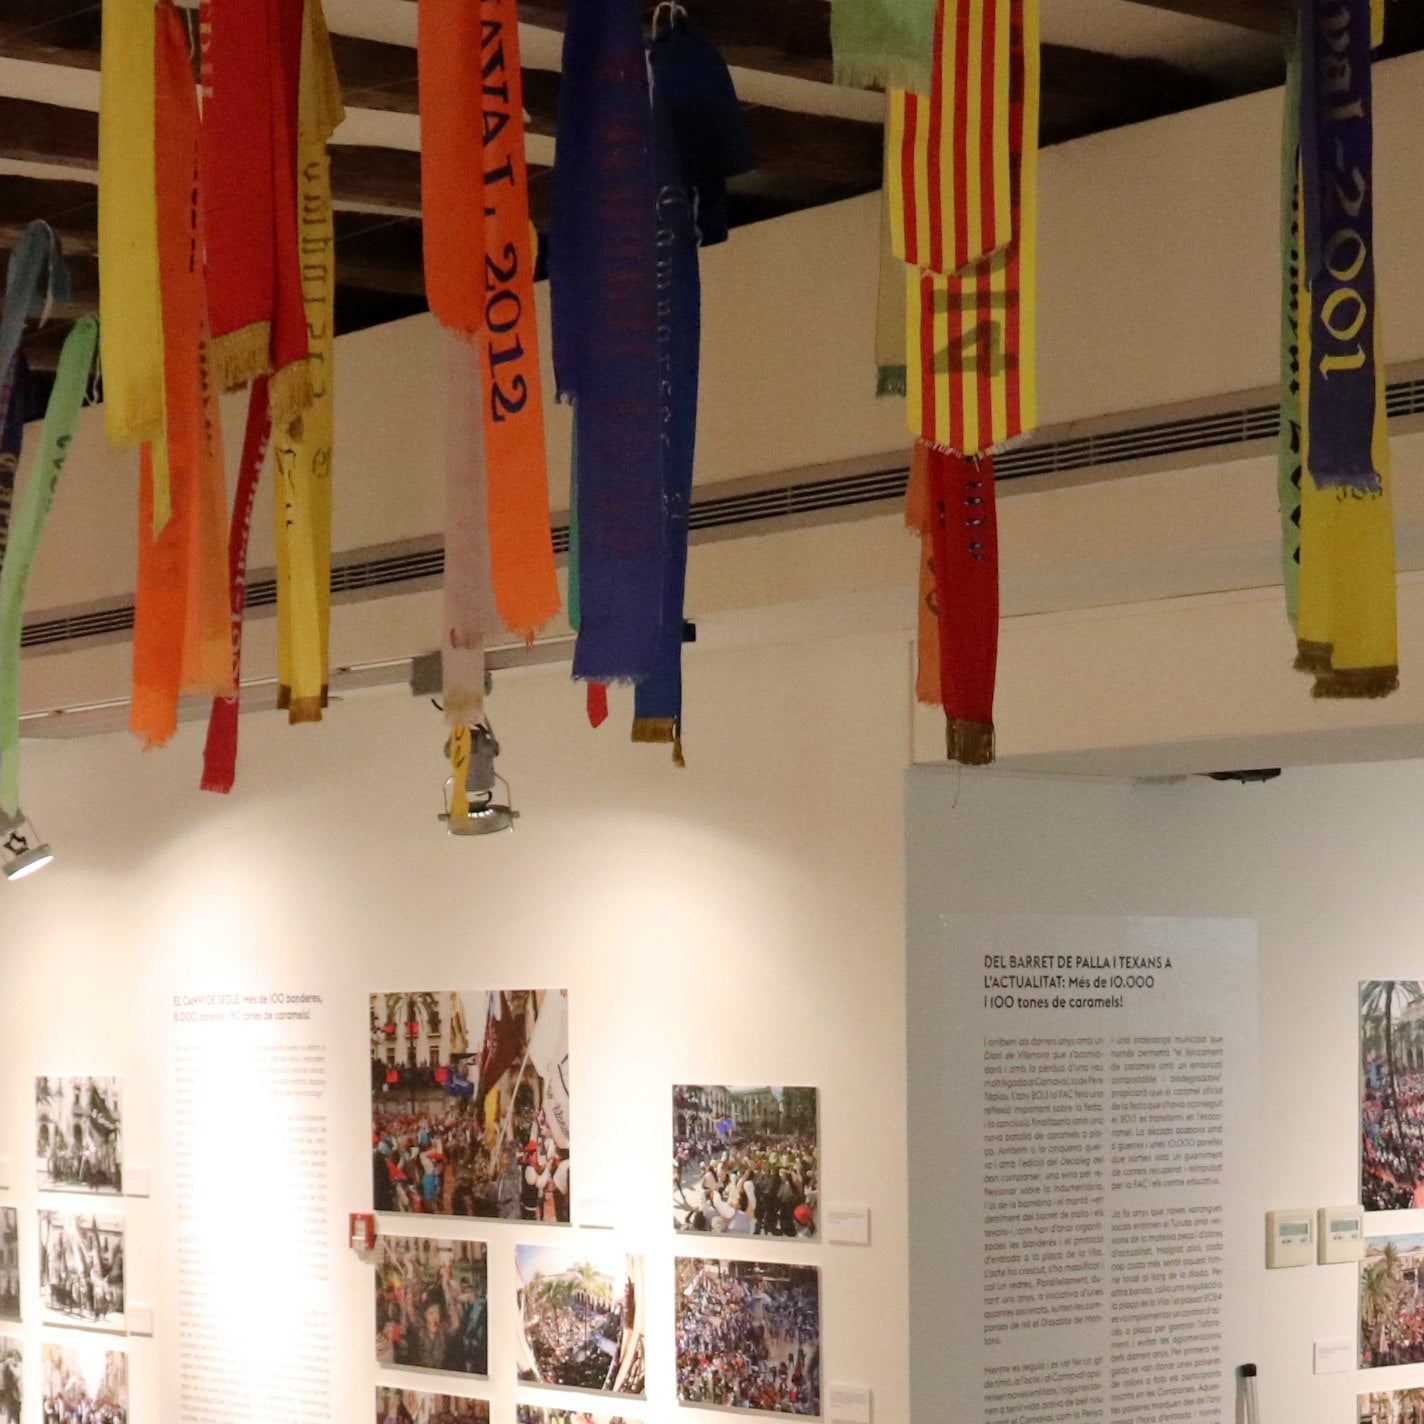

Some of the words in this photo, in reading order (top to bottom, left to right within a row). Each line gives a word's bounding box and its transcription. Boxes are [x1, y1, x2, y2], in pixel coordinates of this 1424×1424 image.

[482, 241, 528, 421] 2012
[983, 955, 1007, 969] DEL
[1009, 955, 1055, 969] BARRET
[1057, 955, 1073, 969] DE
[1075, 955, 1110, 969] PALLA
[1118, 955, 1163, 969] TEXANS
[1164, 955, 1173, 969] A
[983, 975, 1066, 989] L'ACTUALITAT:
[1068, 975, 1091, 988] Més
[1092, 975, 1107, 988] de
[1109, 975, 1155, 989] 10.000
[989, 995, 1014, 1009] 100
[1017, 996, 1049, 1009] tones
[1051, 996, 1066, 1009] de
[1068, 995, 1124, 1009] caramels!
